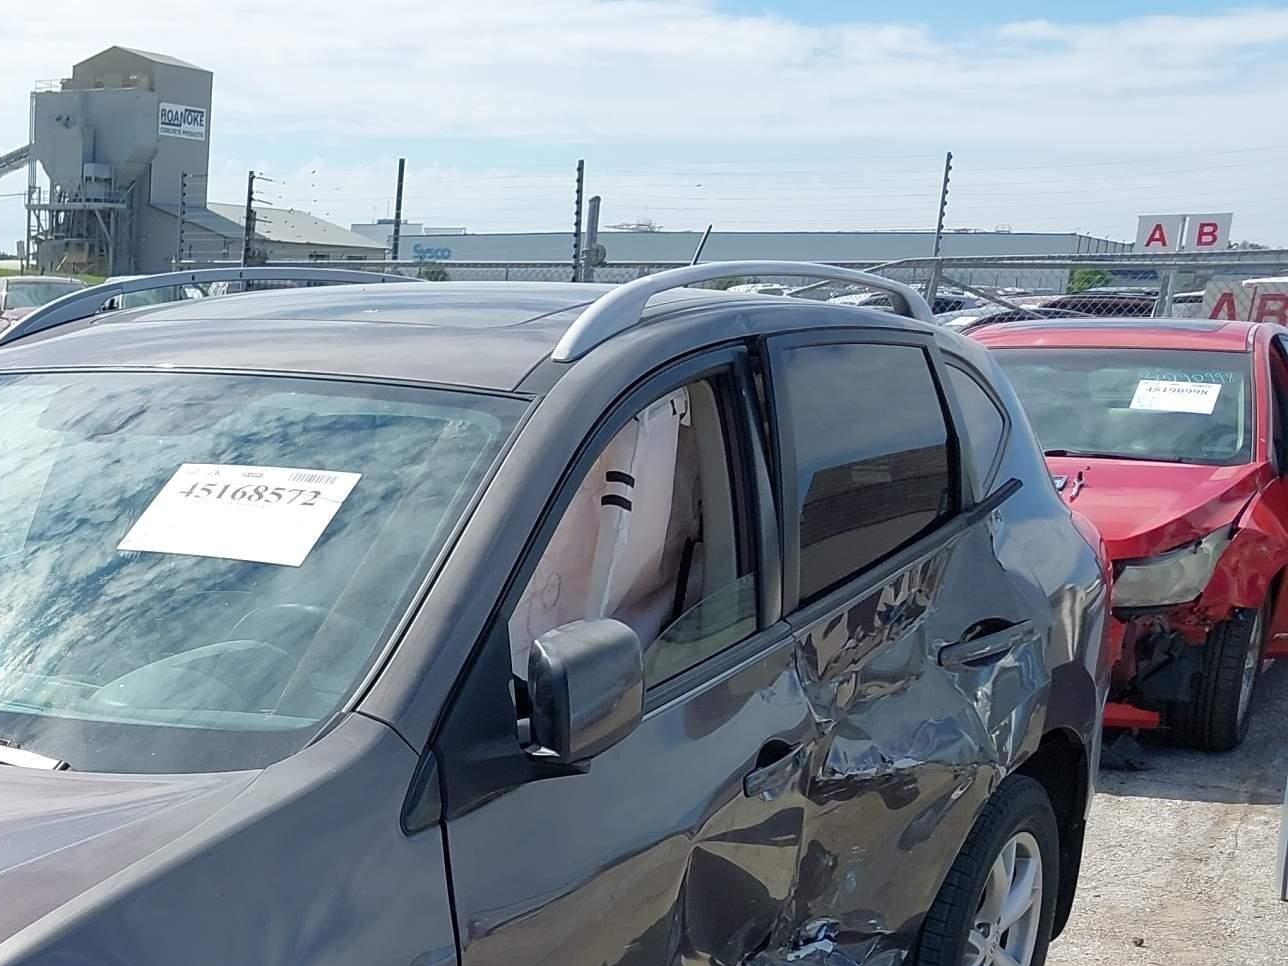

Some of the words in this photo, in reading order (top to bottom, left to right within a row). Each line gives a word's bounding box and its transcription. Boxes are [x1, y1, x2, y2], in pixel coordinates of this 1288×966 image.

[160, 108, 205, 128] ROANOKE
[1144, 223, 1168, 248] A
[1196, 222, 1219, 247] B
[179, 482, 322, 507] 45168572
